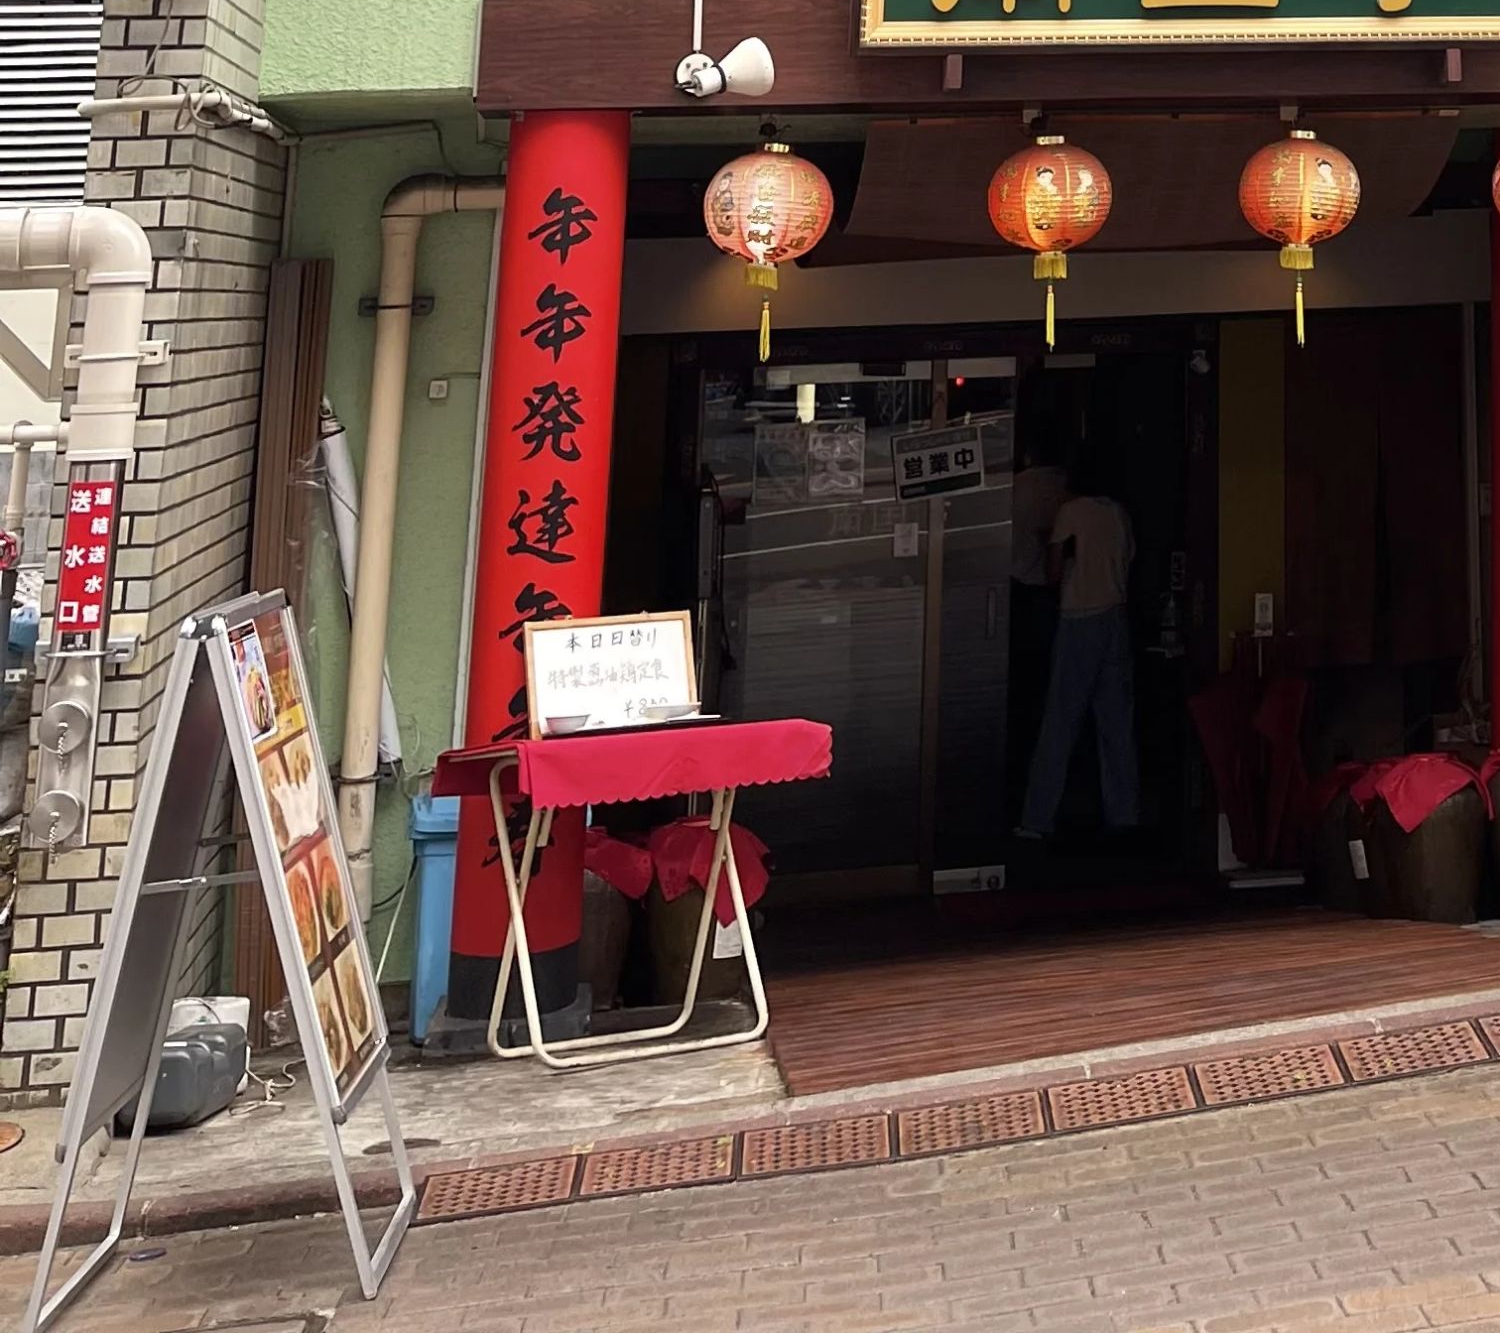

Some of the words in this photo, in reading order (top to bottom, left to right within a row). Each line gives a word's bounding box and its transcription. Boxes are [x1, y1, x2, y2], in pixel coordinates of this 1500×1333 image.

[903, 447, 975, 480] 営業中
[57, 489, 93, 624] 送水口
[82, 487, 113, 624] 連結送水管
